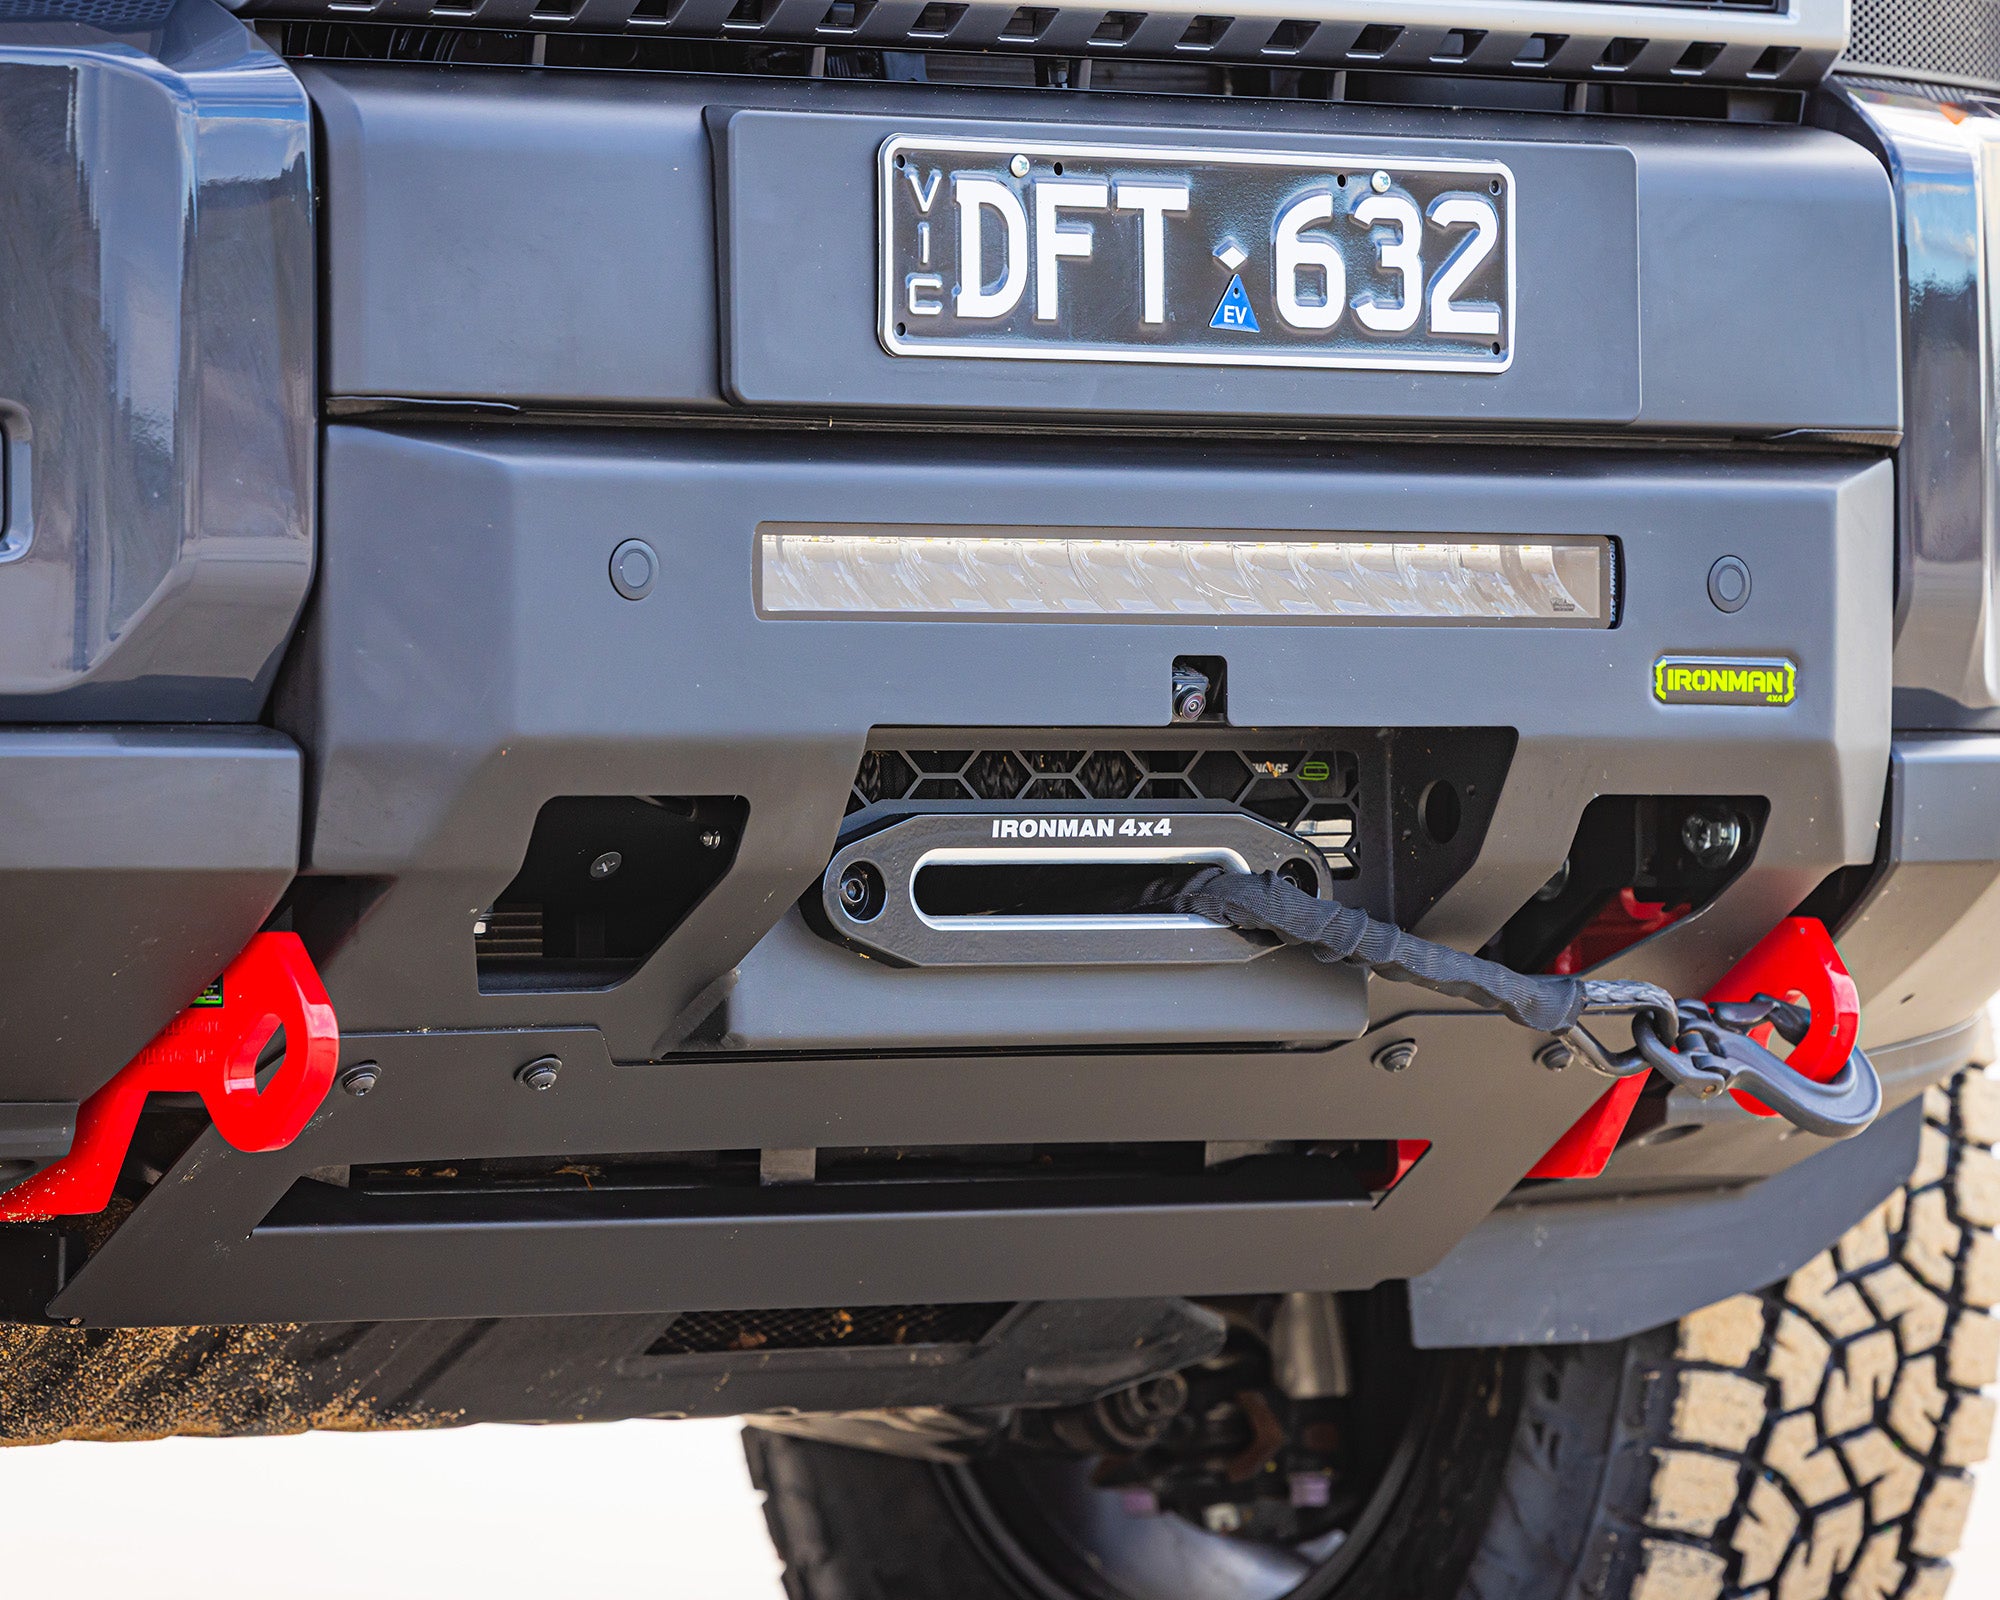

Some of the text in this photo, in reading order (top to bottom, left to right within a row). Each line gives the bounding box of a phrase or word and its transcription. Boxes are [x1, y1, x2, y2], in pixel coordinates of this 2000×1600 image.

[907, 171, 943, 315] VIC
[954, 176, 1501, 334] DFT 632
[1223, 304, 1248, 325] EV
[1667, 668, 1784, 694] IRONMAN
[992, 817, 1172, 839] IRONMAN 4x4
